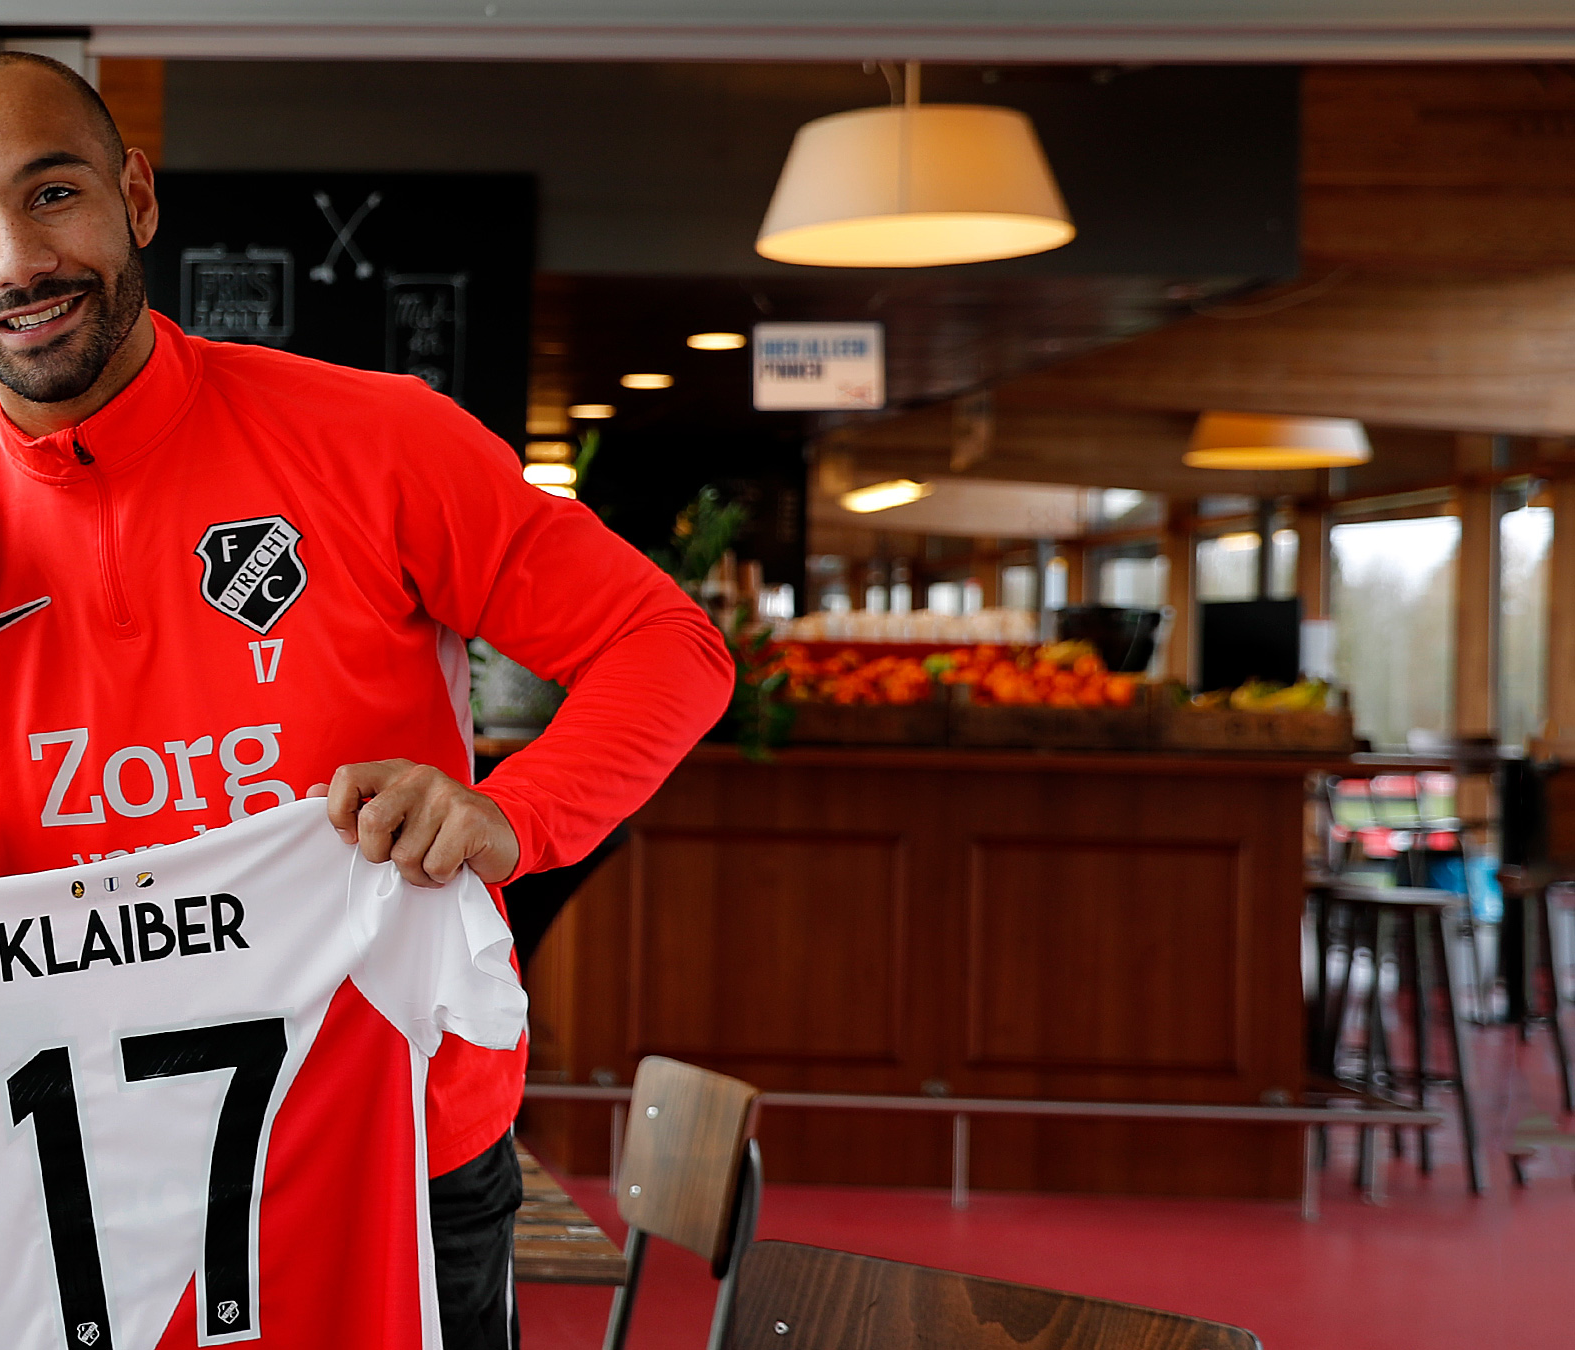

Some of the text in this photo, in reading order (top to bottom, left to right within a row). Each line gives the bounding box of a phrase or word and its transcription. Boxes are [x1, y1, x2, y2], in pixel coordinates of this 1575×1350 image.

[220, 525, 290, 612] UTRECHT
[221, 534, 238, 562] F
[261, 575, 285, 603] C
[248, 638, 284, 684] 17
[28, 723, 295, 827] Zorg
[5, 1015, 290, 1350] 17
